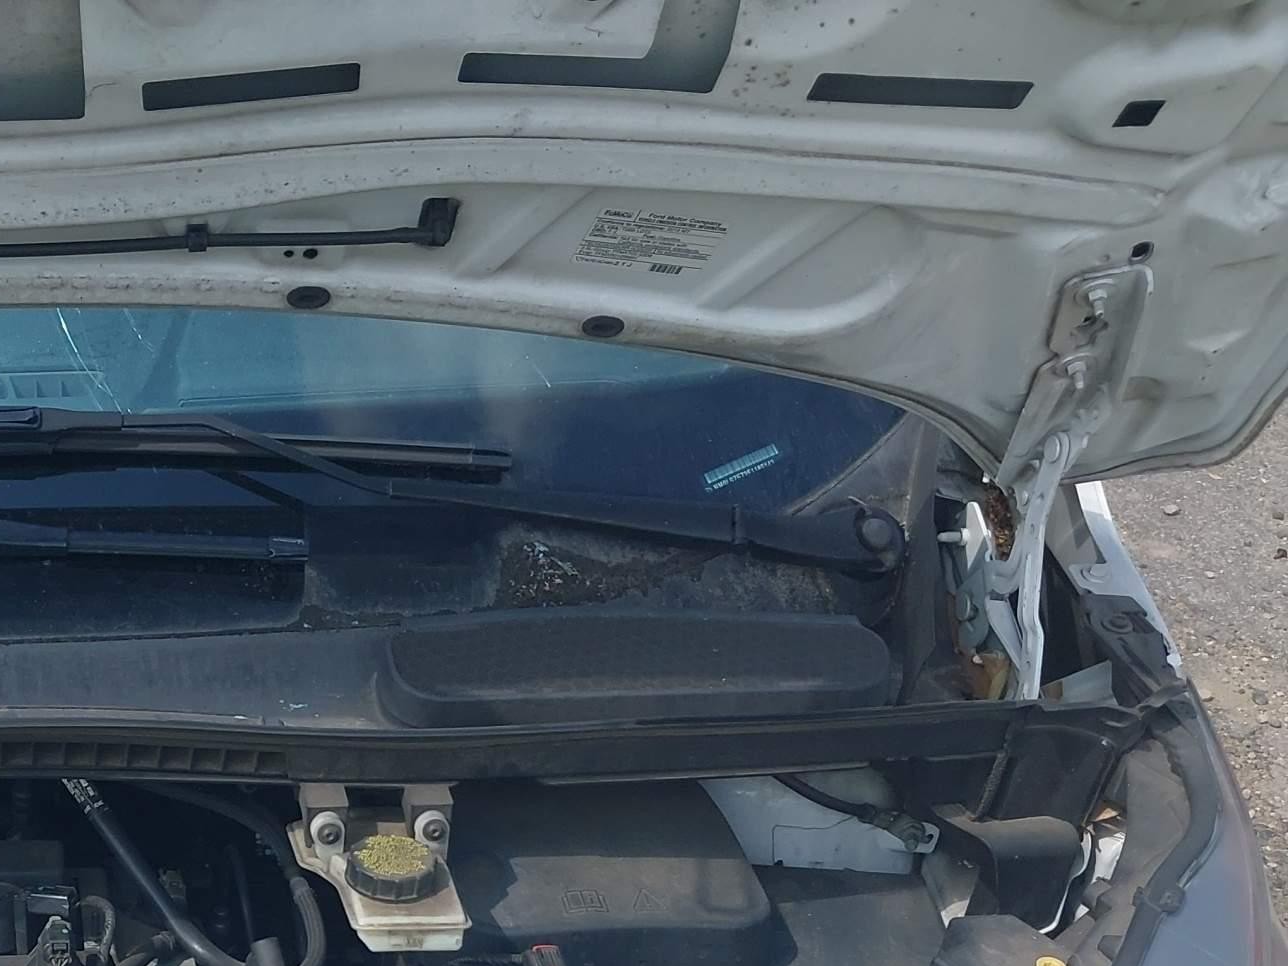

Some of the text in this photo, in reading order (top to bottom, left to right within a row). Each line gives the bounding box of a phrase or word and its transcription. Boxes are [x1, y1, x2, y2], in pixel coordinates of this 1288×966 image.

[649, 212, 666, 220] Ford
[667, 214, 689, 223] Motor
[689, 217, 722, 227] Company
